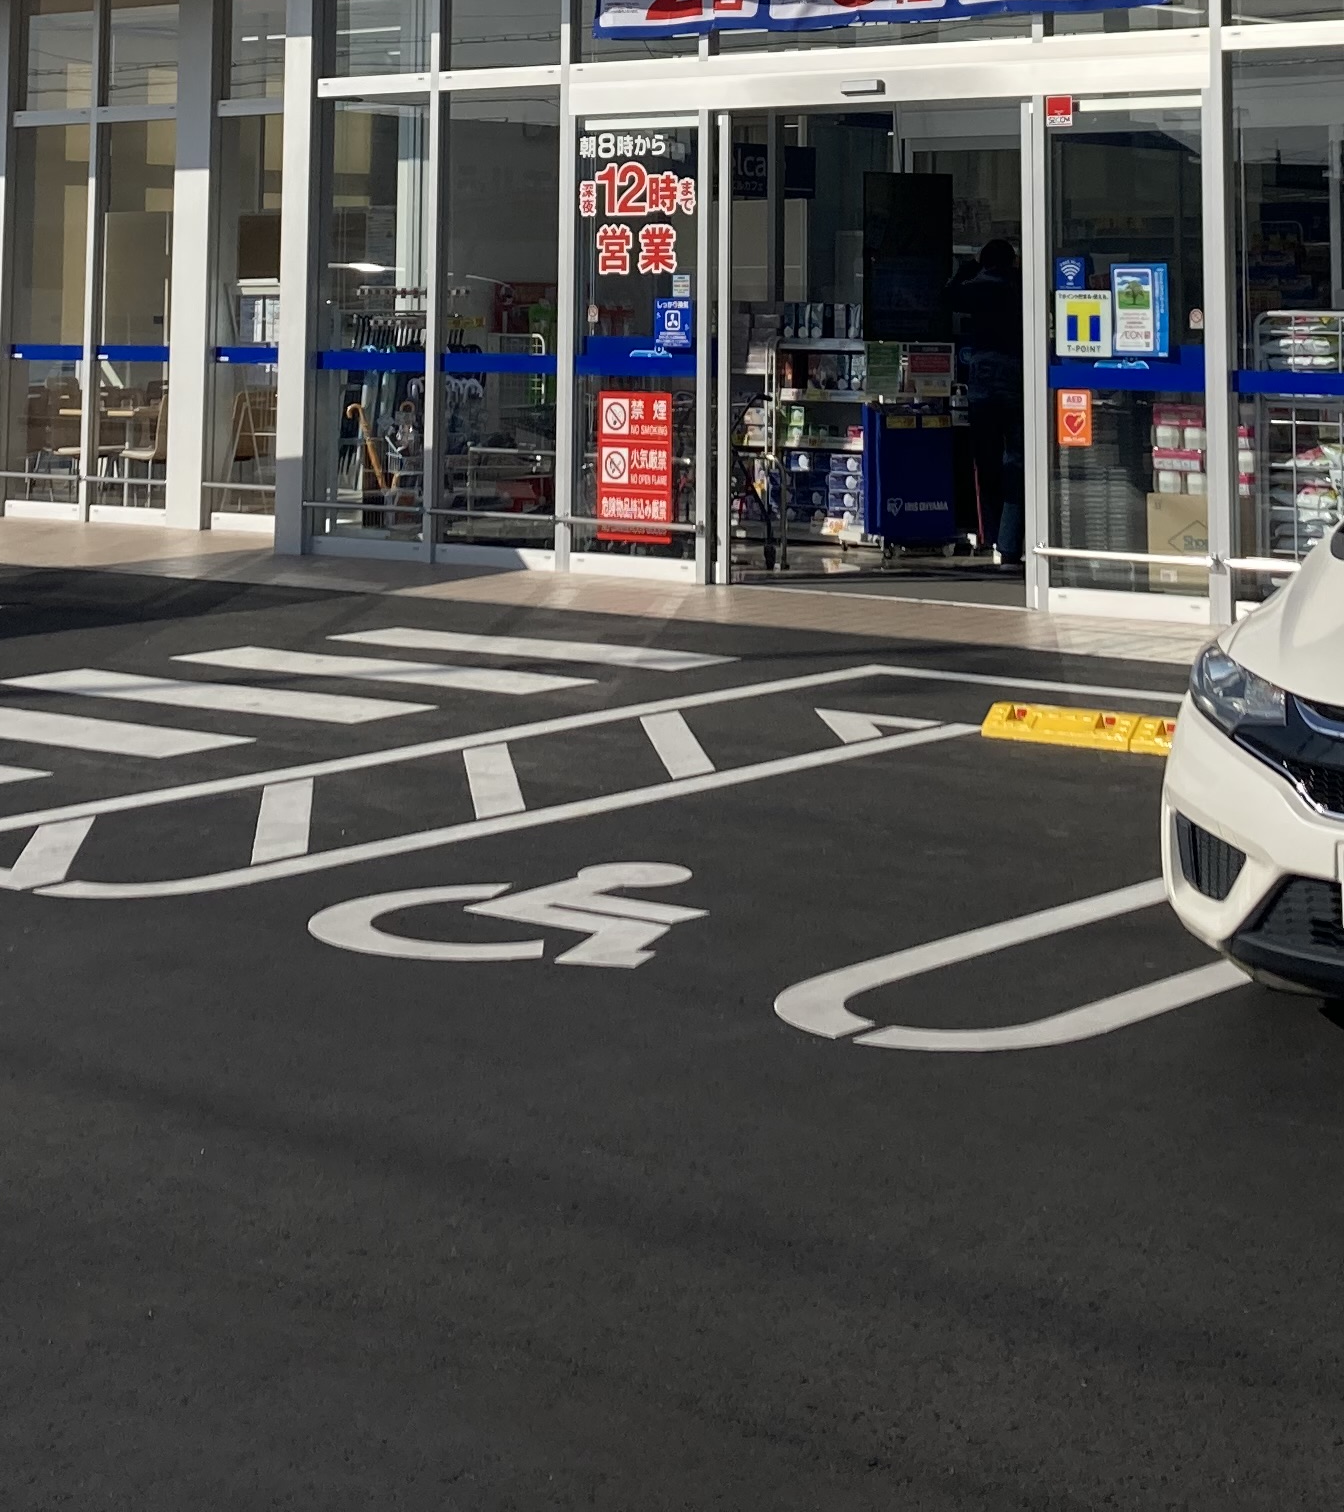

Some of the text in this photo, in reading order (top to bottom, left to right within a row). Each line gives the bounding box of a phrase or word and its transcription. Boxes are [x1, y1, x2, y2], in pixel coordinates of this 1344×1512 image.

[579, 132, 666, 159] 朝8時から
[1066, 345, 1102, 353] T-POINT
[1066, 395, 1083, 403] AED
